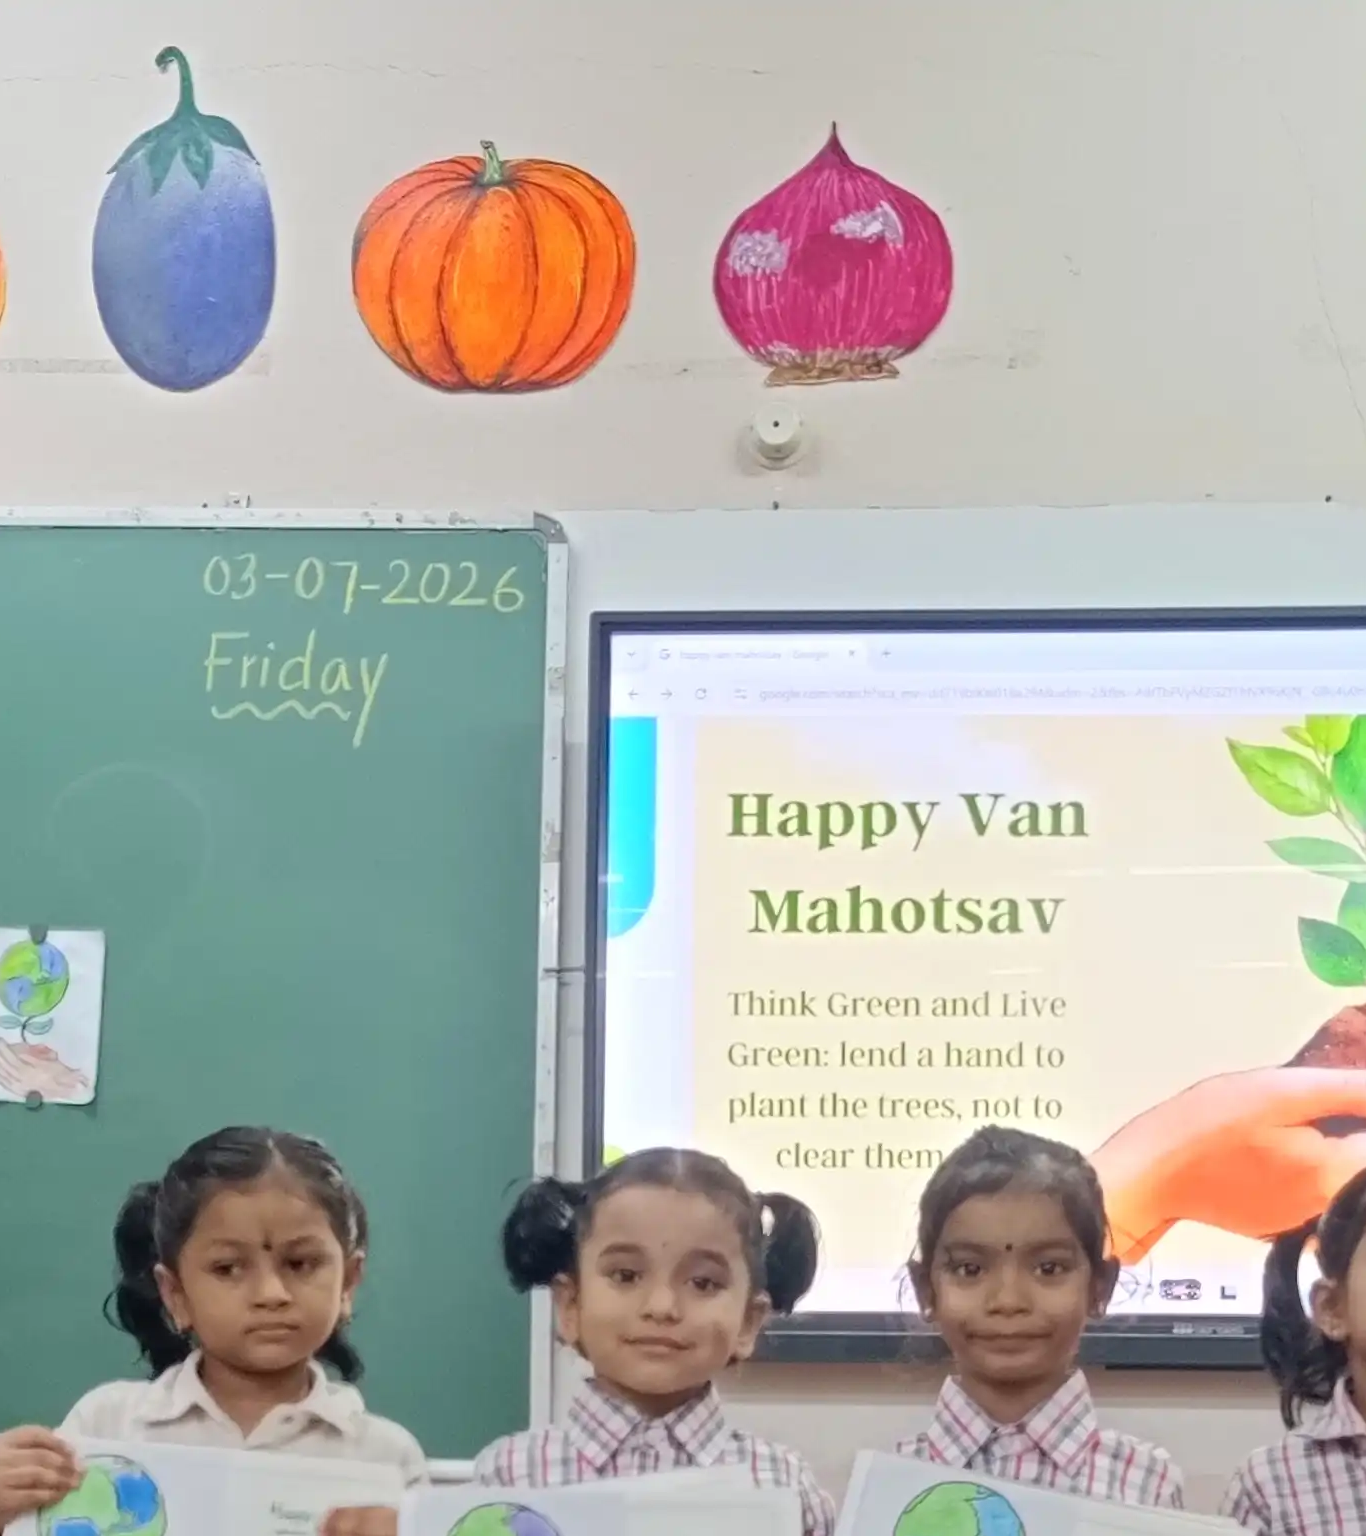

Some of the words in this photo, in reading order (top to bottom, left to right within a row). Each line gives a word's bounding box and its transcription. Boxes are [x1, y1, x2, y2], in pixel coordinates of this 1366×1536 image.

[204, 552, 525, 615] 03-07-2026
[204, 628, 389, 749] Friday
[726, 793, 940, 852] Happy
[958, 793, 1089, 837] Van
[748, 885, 1066, 934] Mahotsav
[728, 990, 818, 1018] Think
[827, 991, 922, 1018] Green
[931, 991, 991, 1018] and
[1001, 990, 1067, 1018] Live
[728, 1042, 830, 1068] Green:
[839, 1041, 907, 1068] lend
[917, 1046, 934, 1068] a
[943, 1041, 1025, 1068] hand
[1035, 1044, 1065, 1068] to
[728, 1092, 808, 1123] plant
[819, 1092, 868, 1119] the
[878, 1096, 963, 1123] trees,
[972, 1095, 1024, 1119] not
[1033, 1095, 1063, 1119] to
[776, 1142, 855, 1169] clear
[864, 1142, 944, 1169] them
